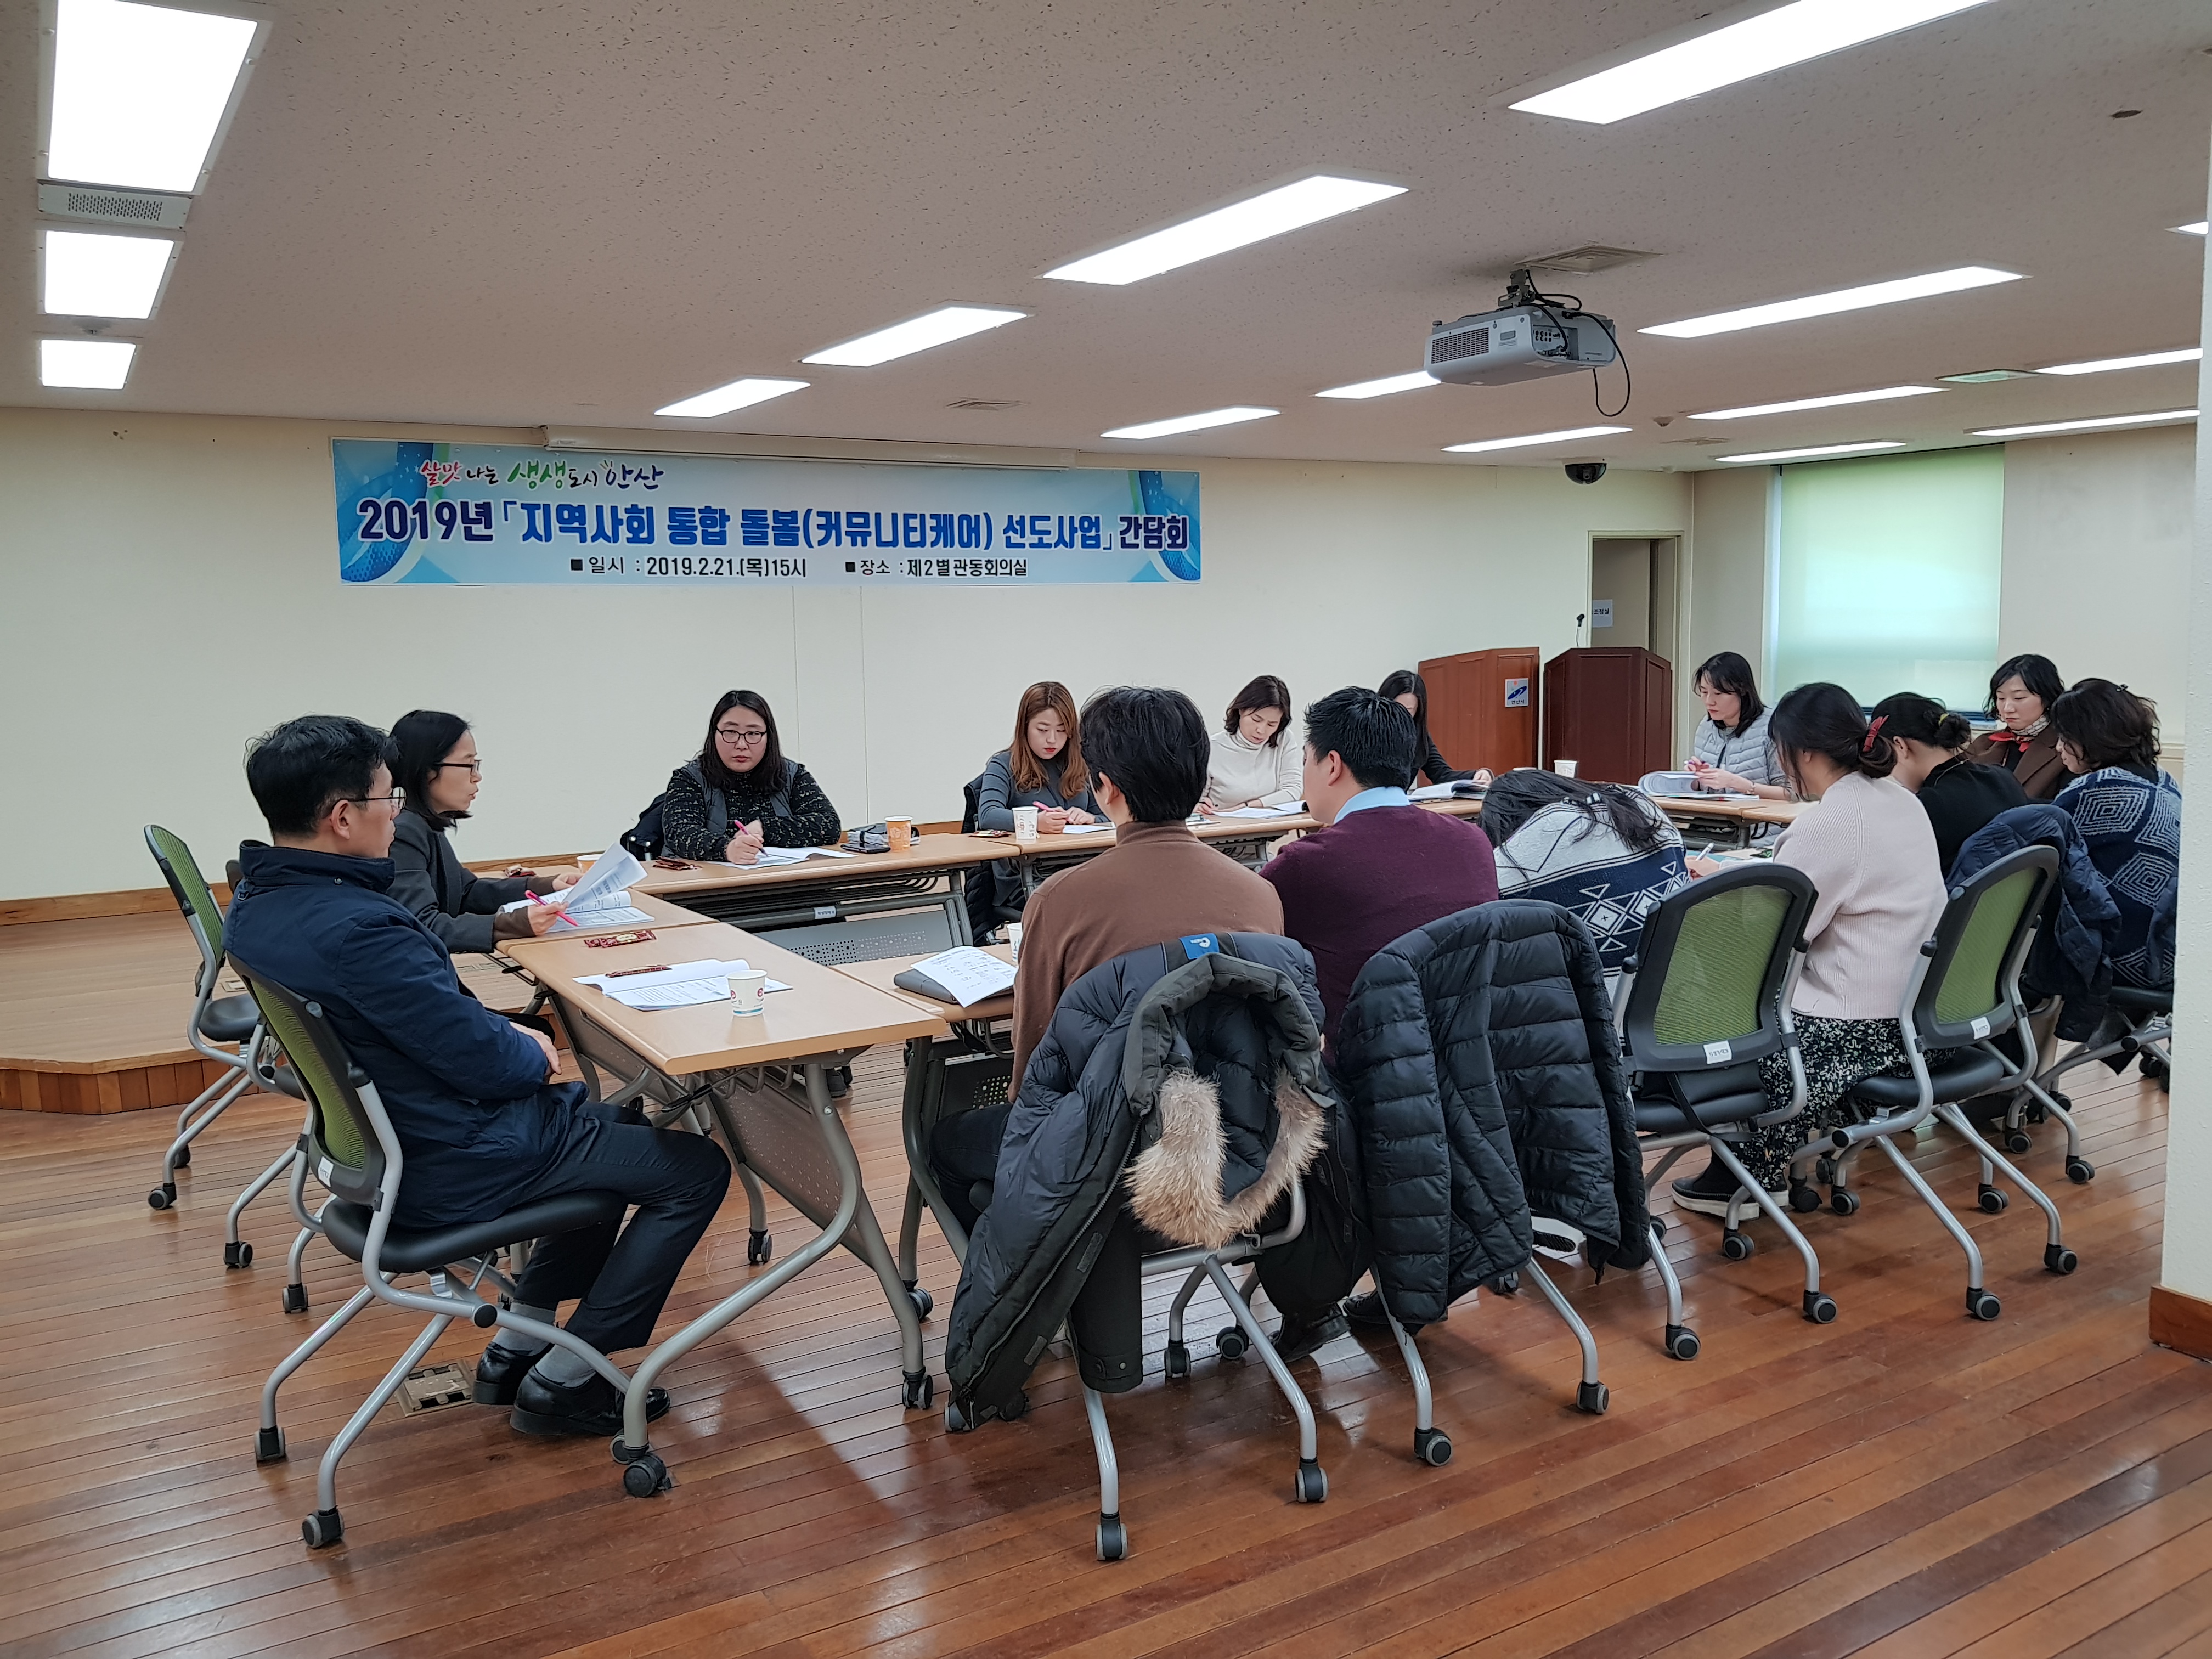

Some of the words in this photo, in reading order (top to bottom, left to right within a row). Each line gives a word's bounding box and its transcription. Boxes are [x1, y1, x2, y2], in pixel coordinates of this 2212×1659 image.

[605, 463, 664, 490] 안산
[359, 499, 493, 541] 2019년
[667, 505, 731, 546] 통합
[741, 508, 992, 550] 돌봄(커뮤니티케어)
[1119, 515, 1188, 549] 간담회
[588, 556, 624, 574] 일시
[860, 559, 891, 575] 장소
